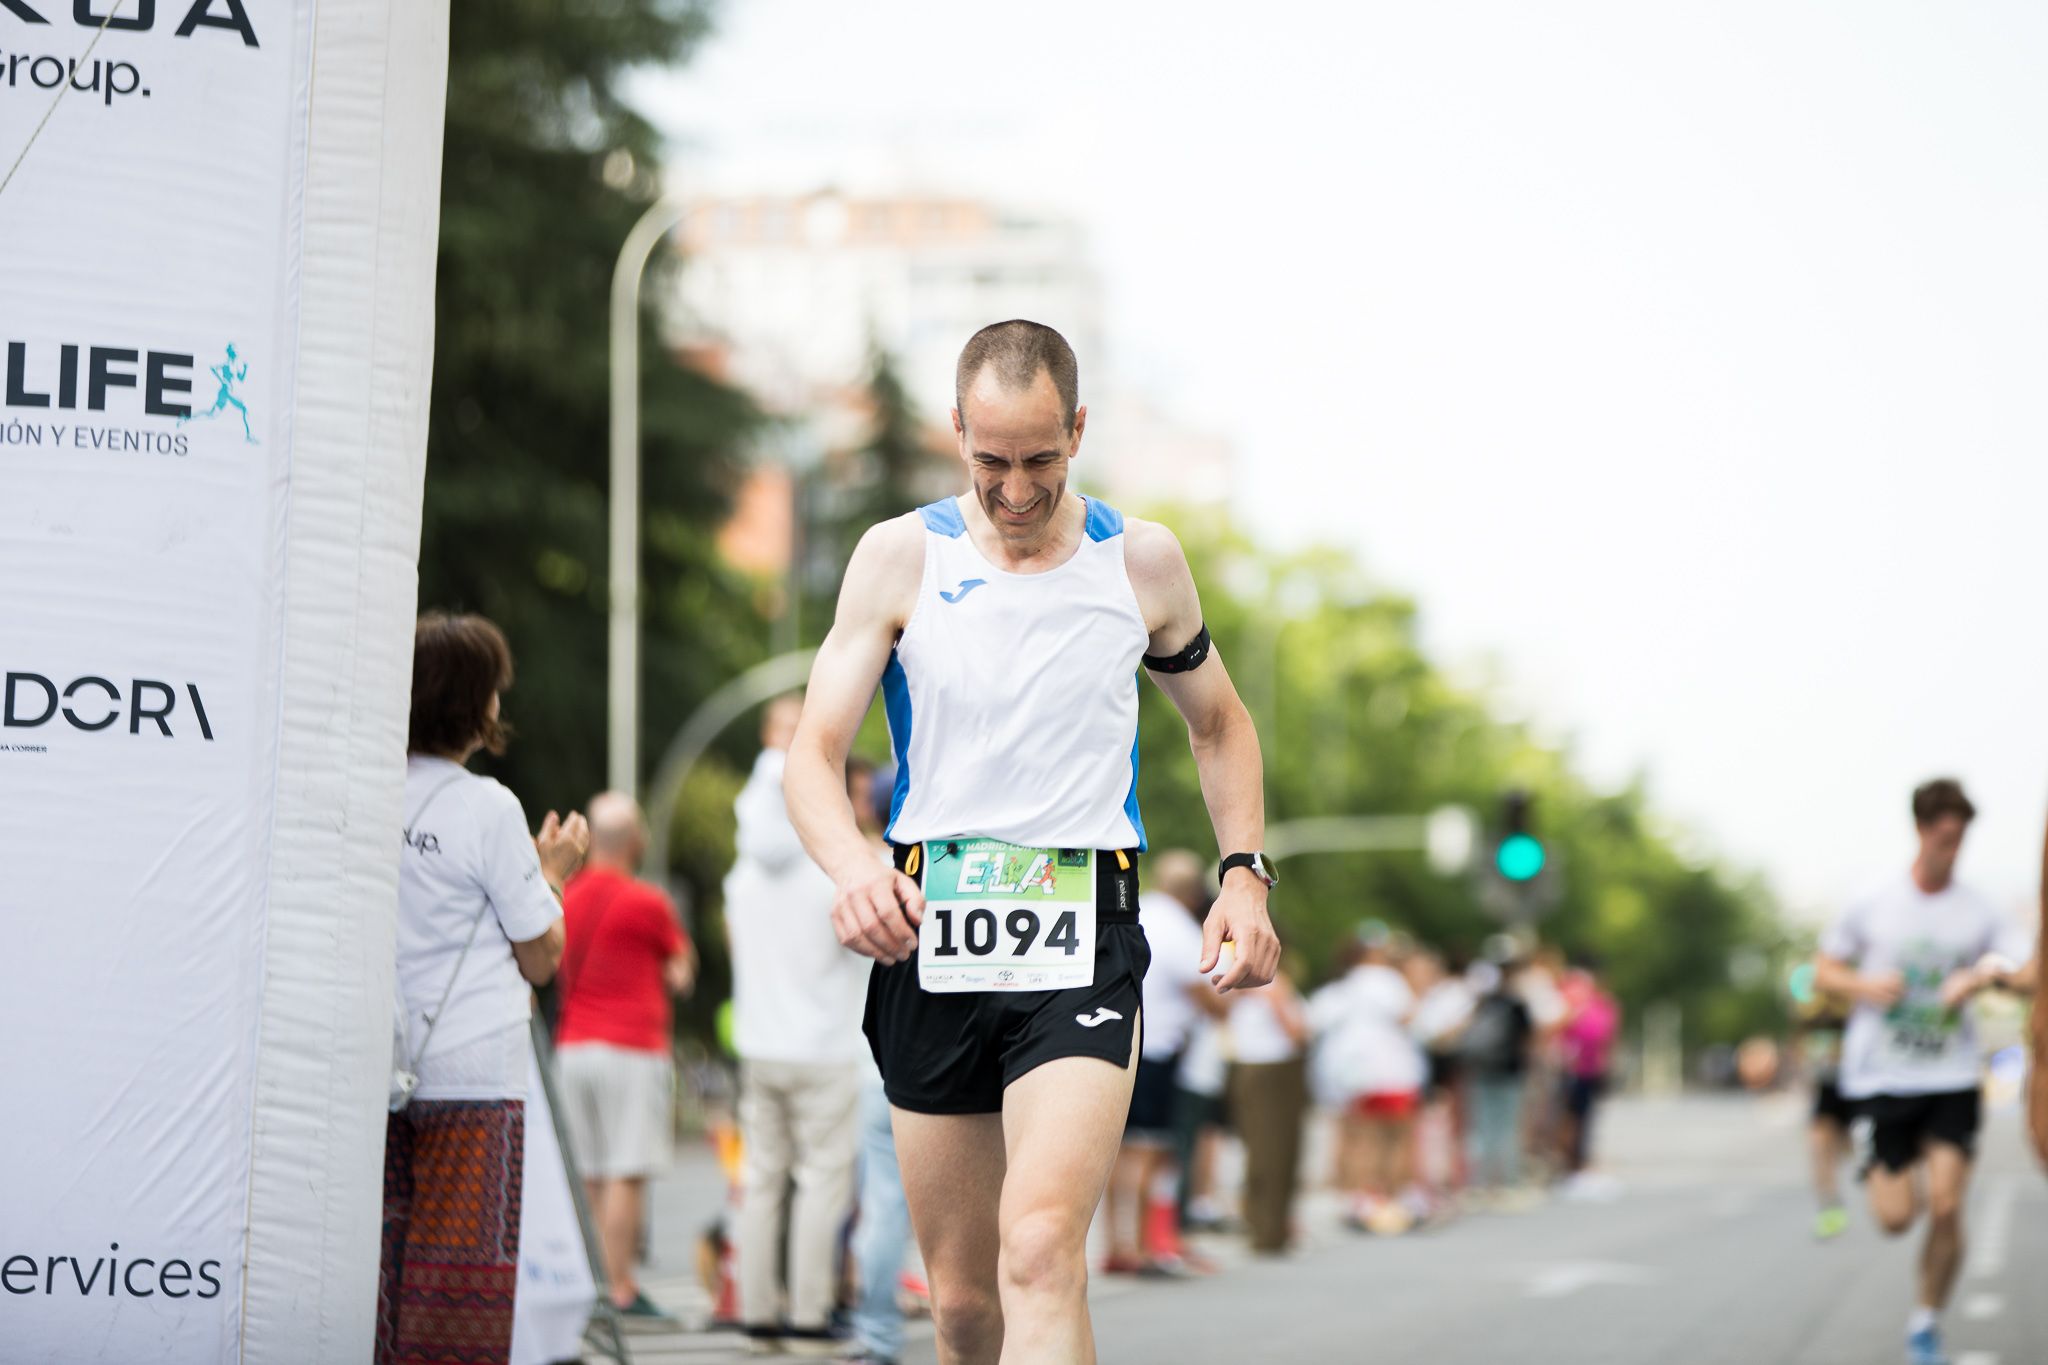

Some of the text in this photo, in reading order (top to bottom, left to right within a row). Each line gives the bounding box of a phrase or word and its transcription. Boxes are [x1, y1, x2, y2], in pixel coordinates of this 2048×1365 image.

[0, 53, 151, 106] roup.
[6, 341, 194, 418] LIFE
[51, 425, 66, 447] Y
[74, 426, 189, 457] EVENTOS
[956, 852, 1055, 894] ELA
[934, 908, 1080, 957] 1094
[1, 1242, 222, 1299] ervices
